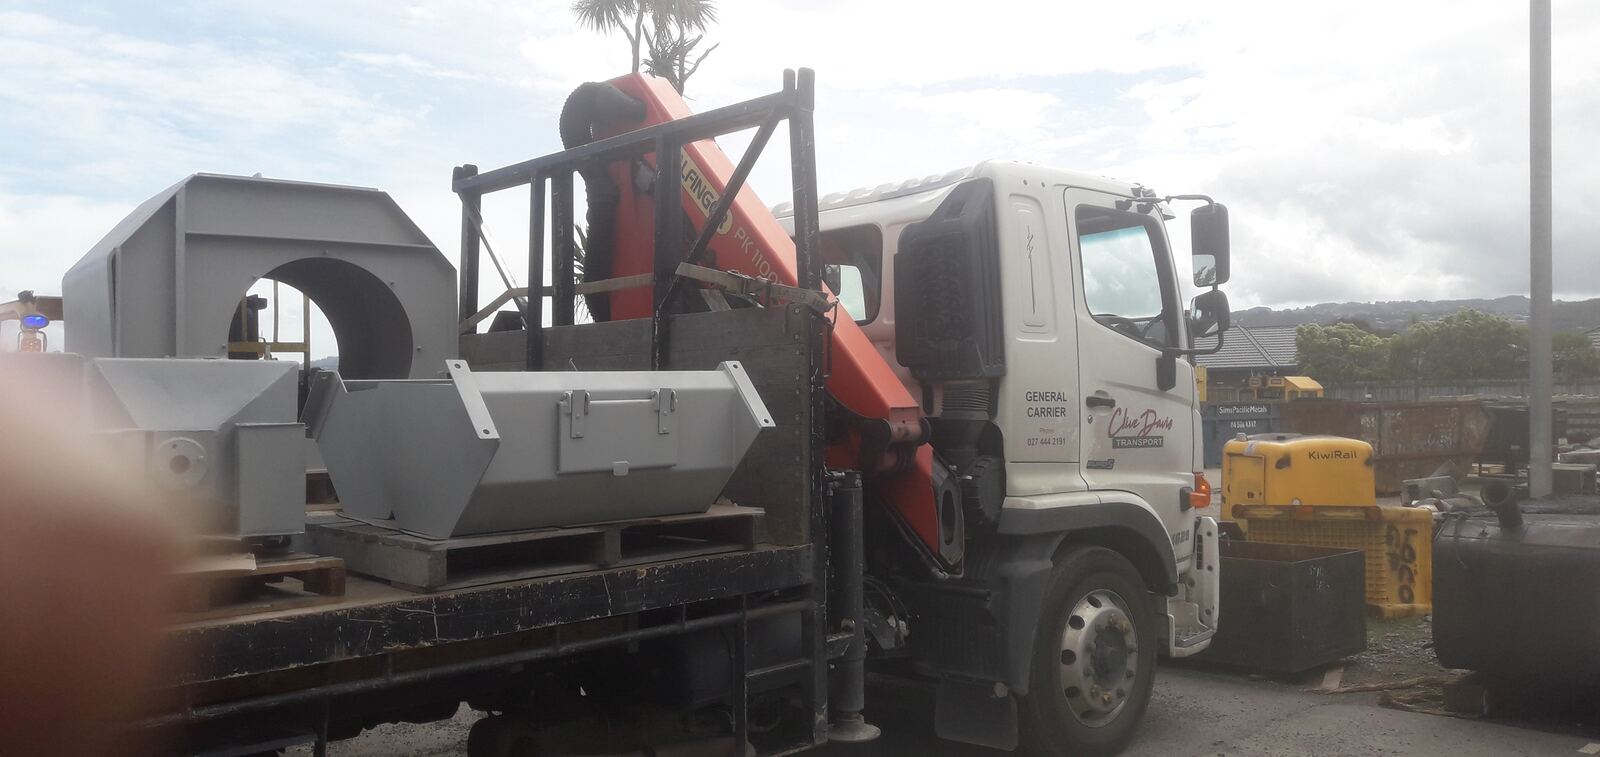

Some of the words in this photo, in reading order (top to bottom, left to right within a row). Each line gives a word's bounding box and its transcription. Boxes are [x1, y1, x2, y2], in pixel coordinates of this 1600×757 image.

[734, 227, 753, 253] PK
[751, 250, 784, 285] 1100
[1025, 391, 1068, 402] GENERAL
[1027, 407, 1066, 418] CARRIER
[1108, 407, 1140, 438] Clive
[1137, 409, 1173, 437] Davis
[1027, 437, 1039, 446] 027
[1116, 438, 1163, 447] TRANSPORT
[1308, 450, 1358, 460] KiwiRail
